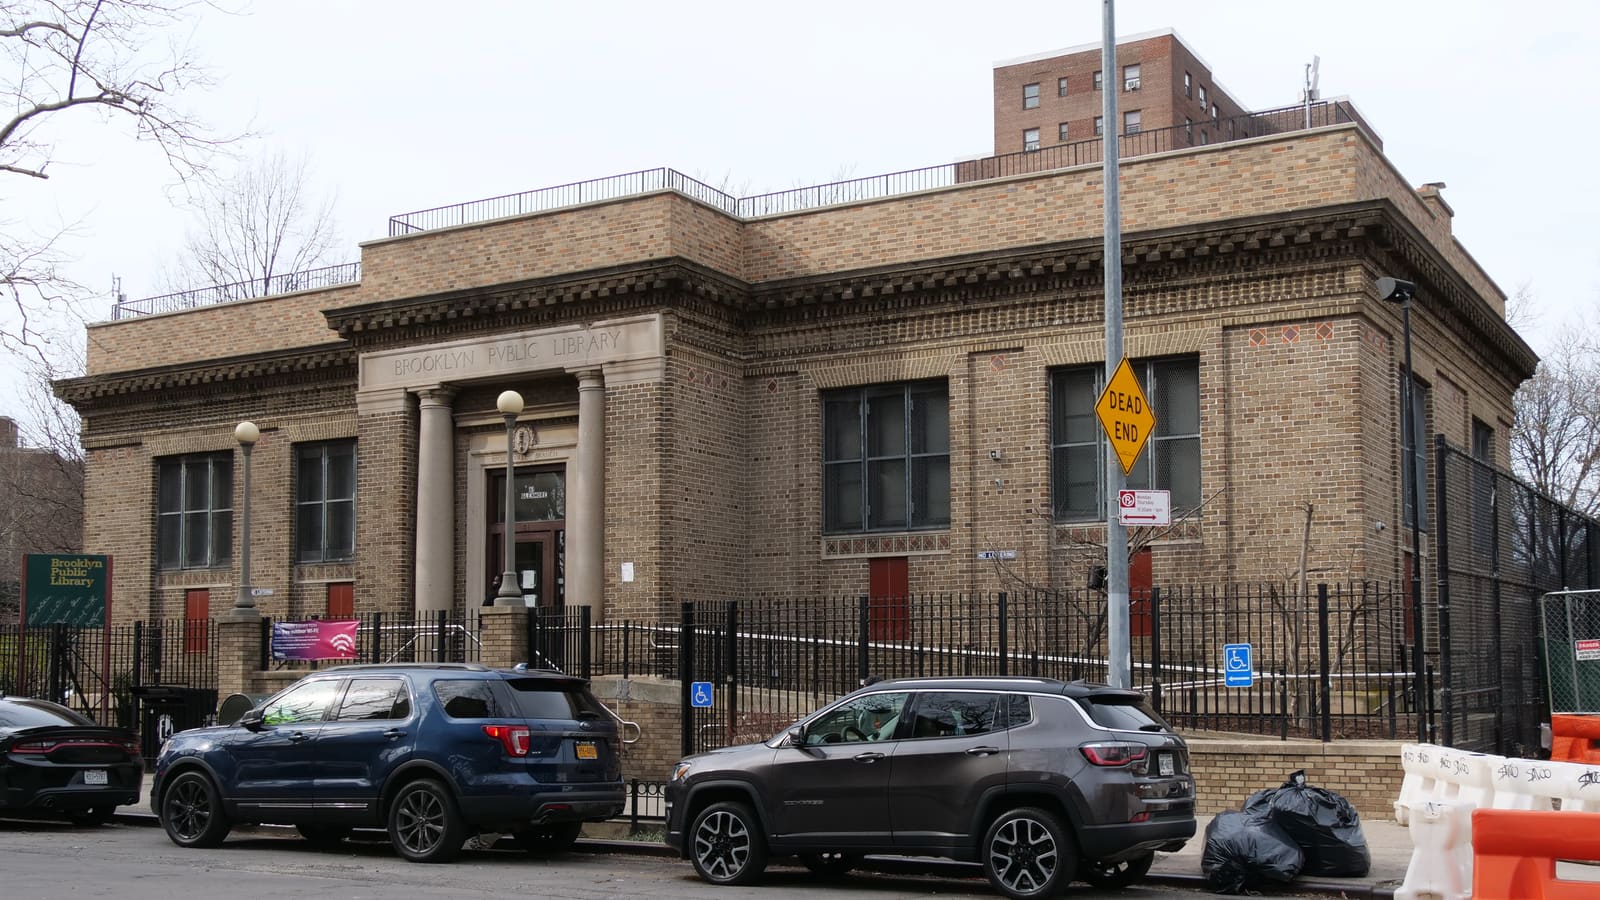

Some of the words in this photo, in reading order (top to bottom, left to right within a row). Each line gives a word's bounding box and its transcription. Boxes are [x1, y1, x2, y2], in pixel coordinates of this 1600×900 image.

[394, 350, 475, 376] BROOKLYN
[553, 331, 621, 356] LIBRARY
[1110, 390, 1142, 414] DEAD
[1115, 421, 1138, 443] END
[50, 558, 103, 570] Brooklyn
[50, 567, 88, 576] Public
[50, 576, 95, 588] Library
